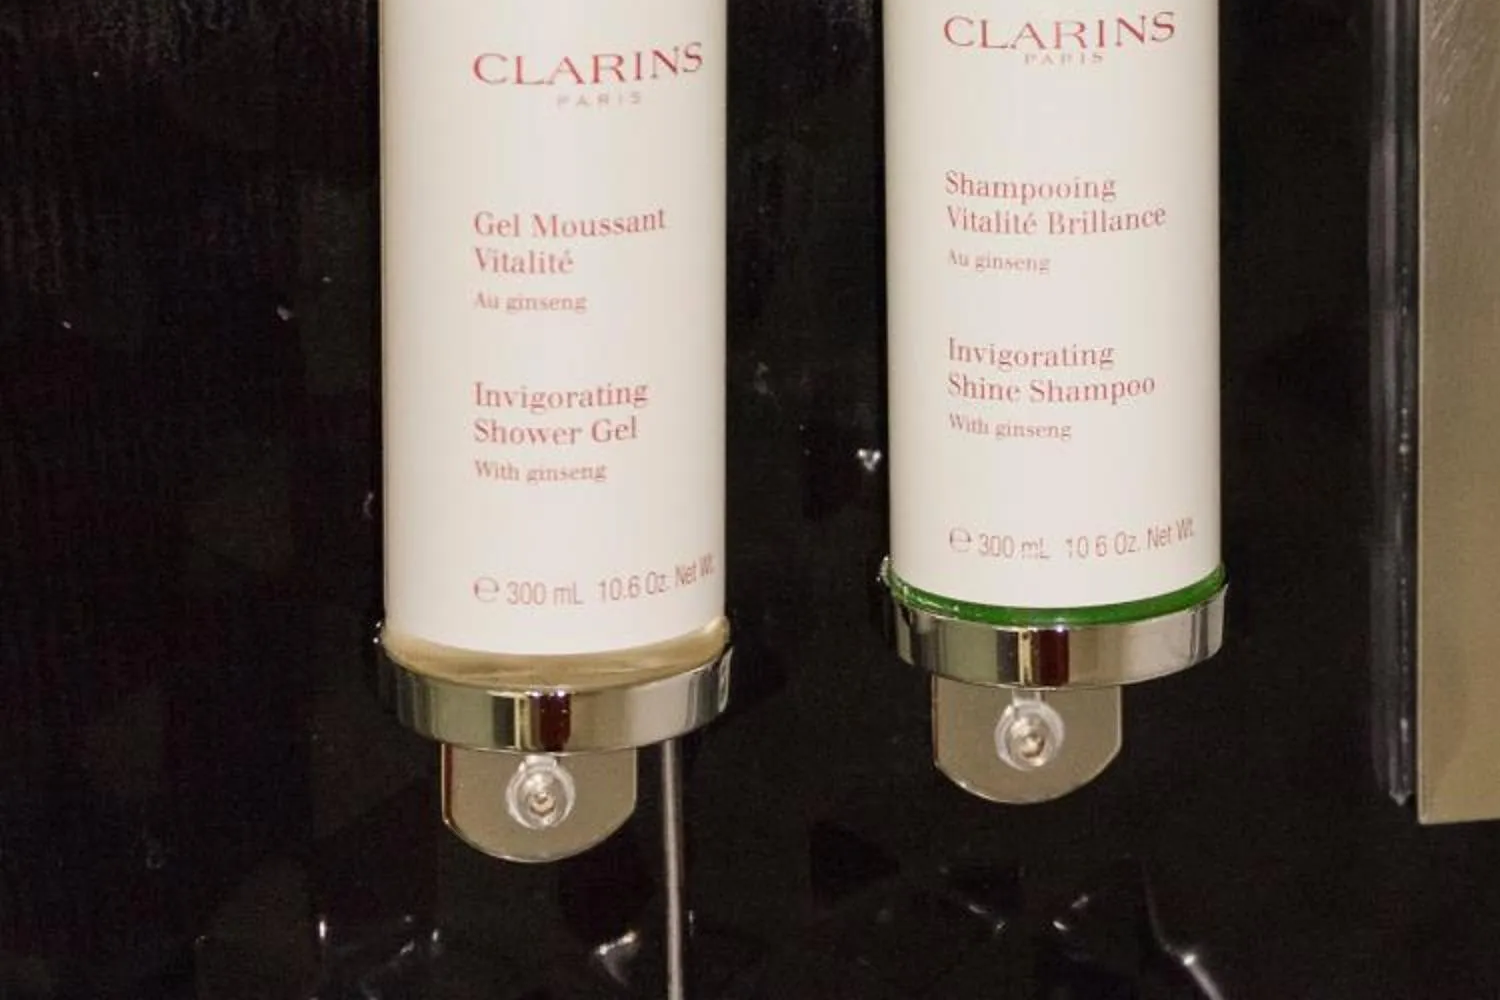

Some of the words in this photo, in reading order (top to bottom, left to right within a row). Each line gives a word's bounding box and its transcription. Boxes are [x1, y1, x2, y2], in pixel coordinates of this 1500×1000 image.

[945, 11, 1175, 50] CLARINS
[473, 42, 704, 86] CLARINS
[1024, 52, 1104, 66] PARIS
[556, 91, 642, 108] PARIS
[945, 170, 1117, 206] Shampooing
[473, 211, 521, 238] Gel
[532, 208, 666, 238] Moussant
[947, 206, 1037, 235] Vitalité
[1048, 207, 1167, 236] Brillance
[474, 248, 574, 275] Vitalité
[949, 249, 968, 267] Au
[975, 253, 1051, 275] ginseng
[474, 292, 499, 311] Au
[505, 295, 588, 314] ginseng
[949, 337, 1114, 371] Invigorating
[473, 381, 649, 415] Invigorating
[949, 372, 1021, 403] Shine
[1030, 377, 1156, 405] Shampoo
[473, 418, 583, 446] Shower
[591, 416, 638, 442] Gel
[949, 412, 989, 436] With
[995, 420, 1073, 441] ginseng
[474, 459, 520, 482] With
[526, 464, 608, 485] ginseng
[979, 532, 1015, 560] 300
[1066, 534, 1109, 559] 106
[1147, 524, 1172, 549] Net
[506, 581, 547, 607] 300
[598, 574, 641, 602] 10.6
[674, 560, 697, 589] Net
